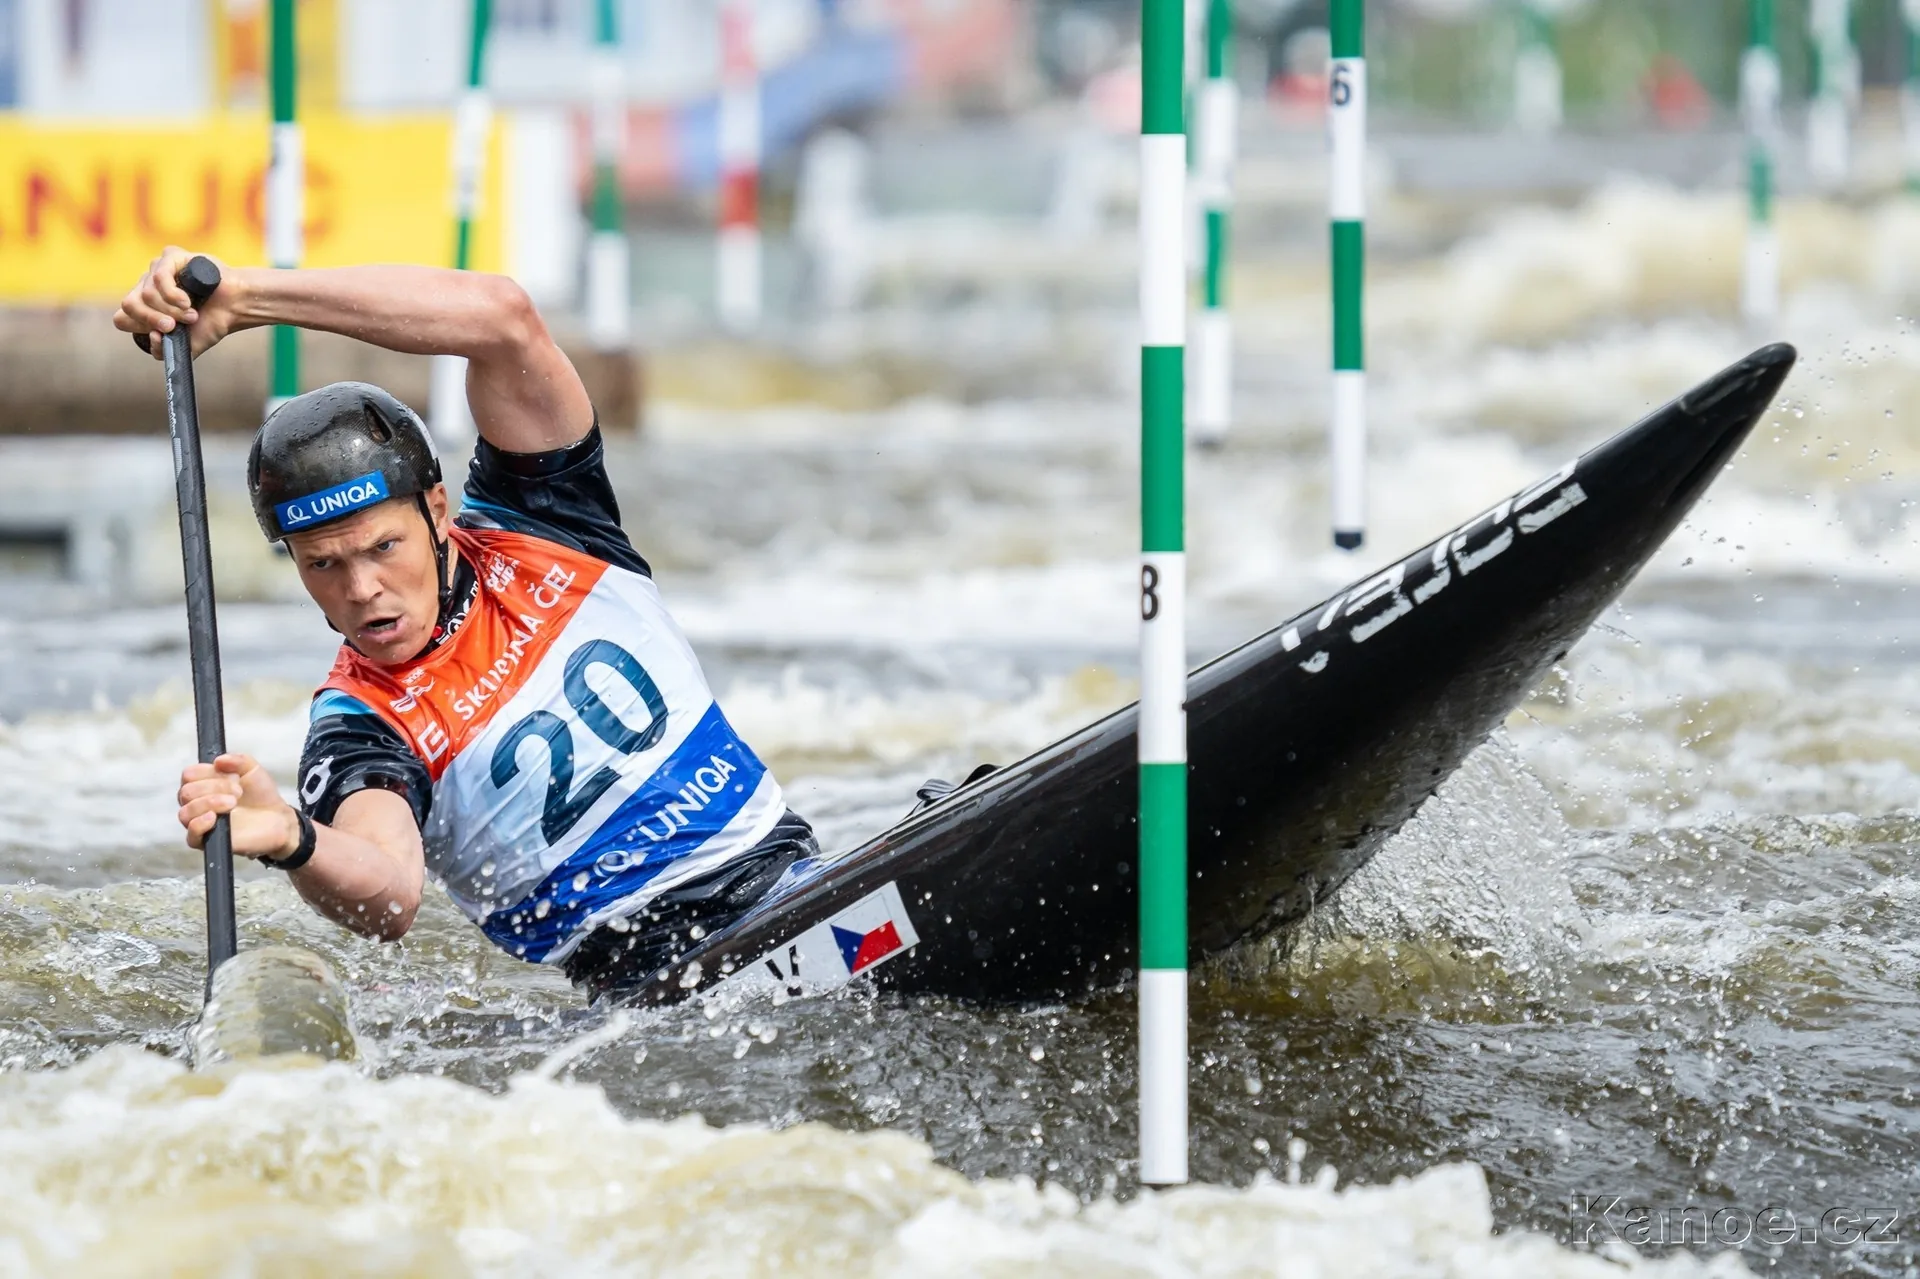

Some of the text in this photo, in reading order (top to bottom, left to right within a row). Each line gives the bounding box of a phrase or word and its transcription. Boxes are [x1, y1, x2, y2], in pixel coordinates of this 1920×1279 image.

[1331, 64, 1351, 107] 6
[0, 163, 335, 243] NUC
[310, 481, 380, 516] UNIQA
[493, 565, 516, 593] Cup
[527, 562, 577, 609] ČEZ
[1141, 564, 1159, 621] 8
[490, 639, 670, 847] 20
[638, 754, 738, 842] UNIQA
